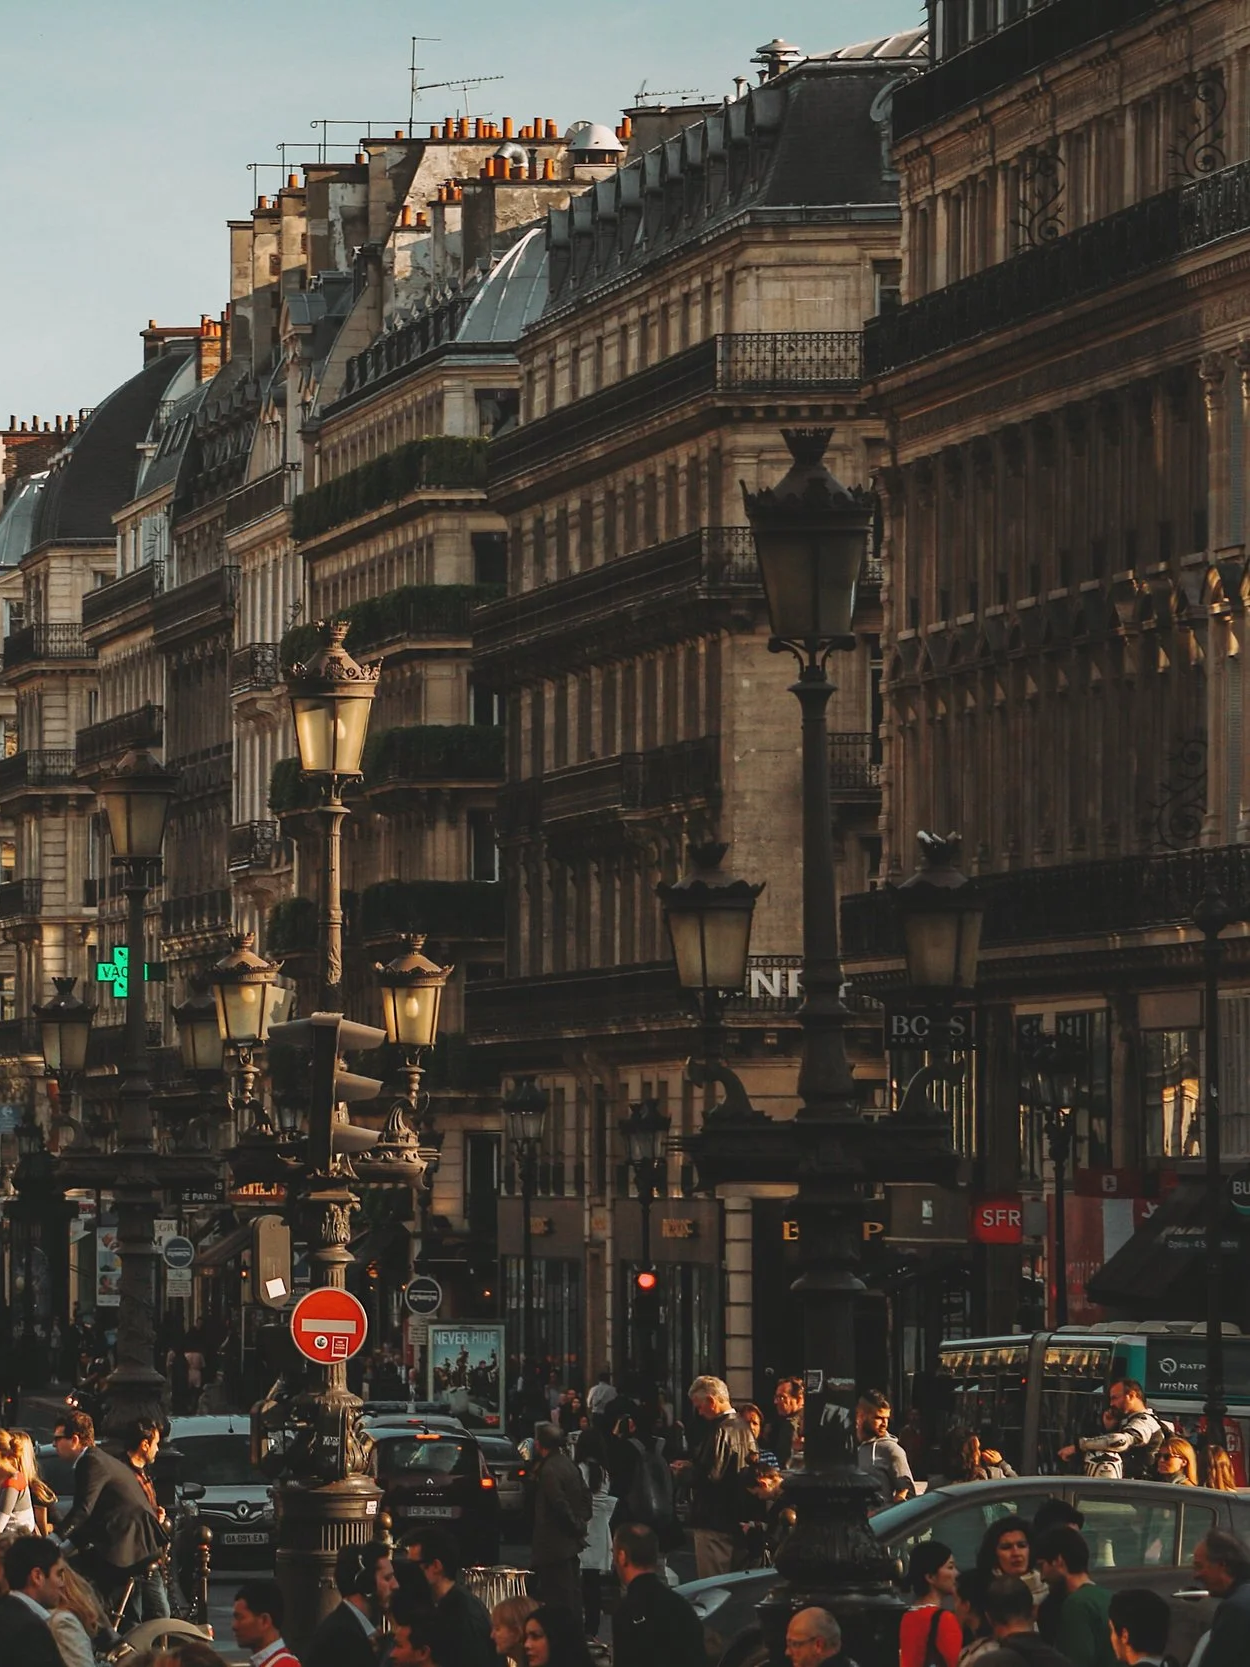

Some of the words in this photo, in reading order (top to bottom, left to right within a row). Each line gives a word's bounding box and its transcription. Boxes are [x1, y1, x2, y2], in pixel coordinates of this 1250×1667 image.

[982, 1209, 1022, 1227] SFR
[434, 1331, 469, 1345] NEVER
[472, 1331, 498, 1345] HIDE
